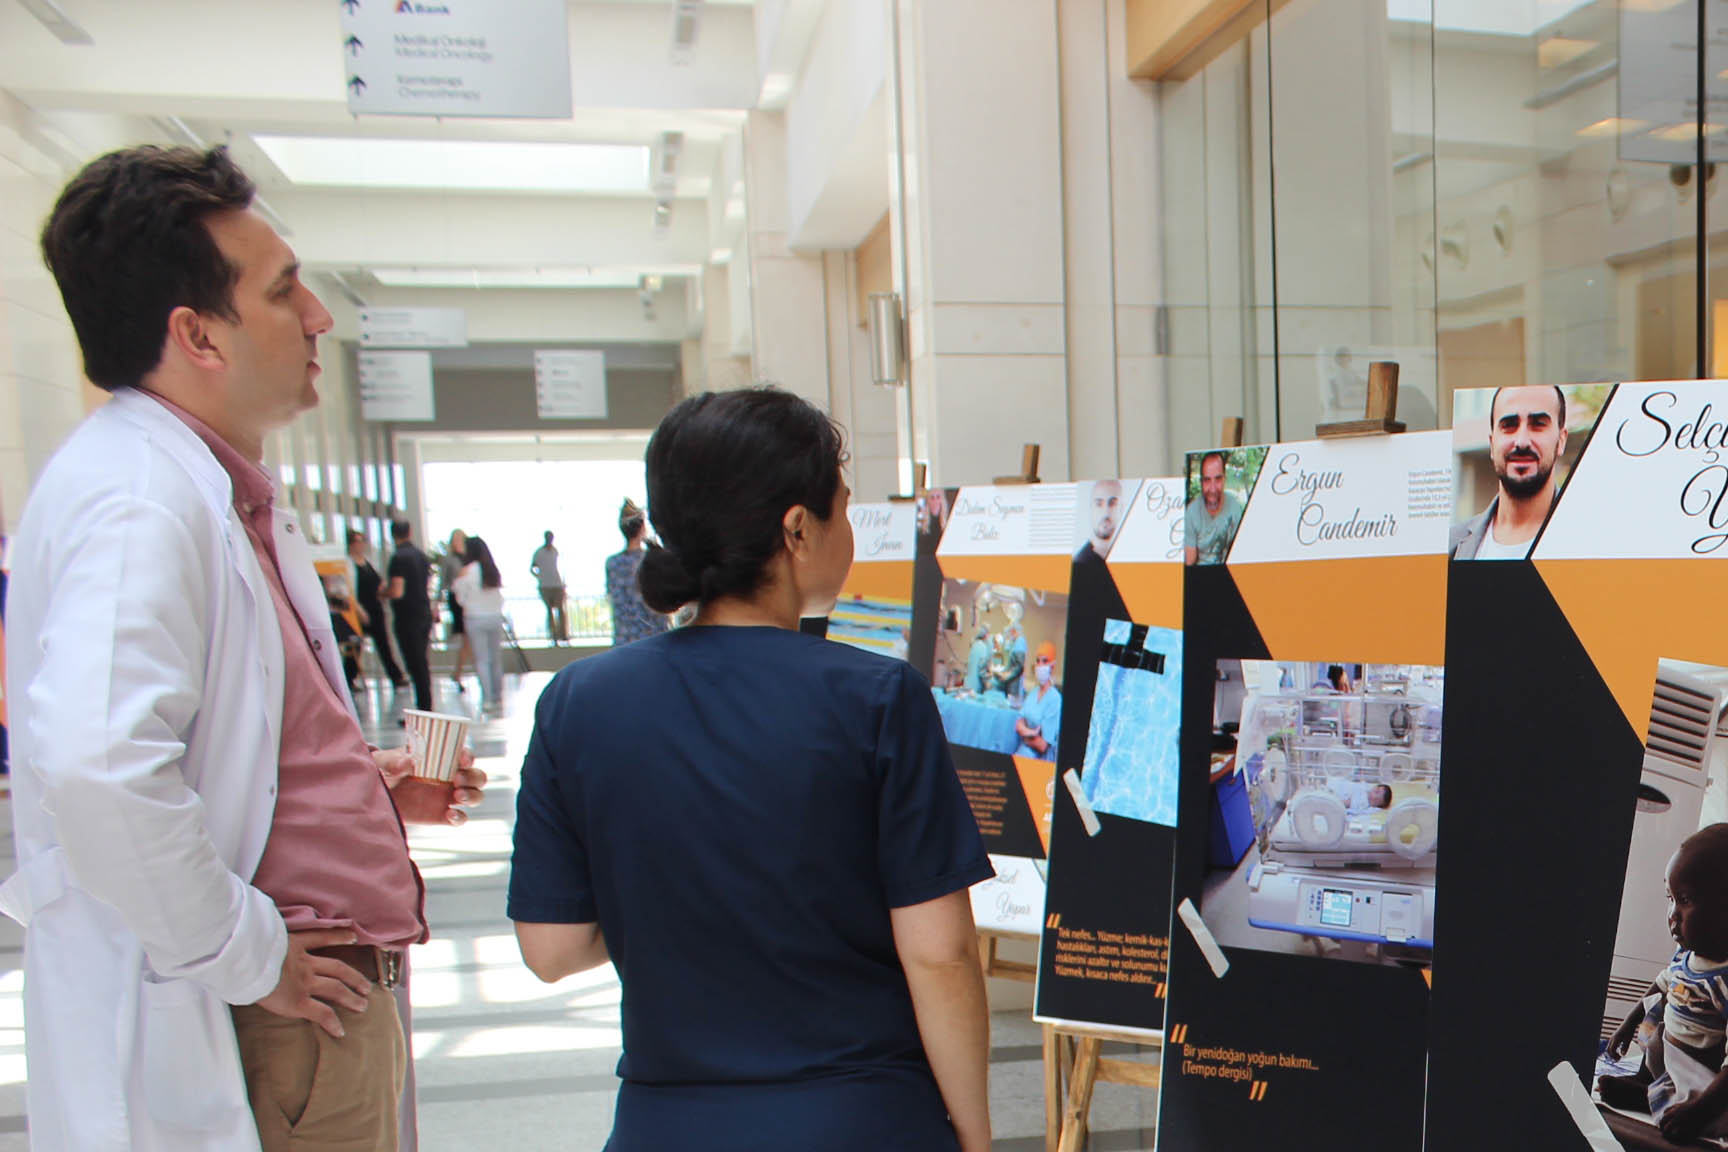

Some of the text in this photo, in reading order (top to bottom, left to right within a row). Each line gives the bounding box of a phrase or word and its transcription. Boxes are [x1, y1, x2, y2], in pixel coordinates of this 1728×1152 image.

[1272, 453, 1344, 505] Ergun
[1297, 503, 1398, 546] Candemir
[1197, 1046, 1245, 1064] yenidoğan
[1247, 1052, 1277, 1068] yoğun
